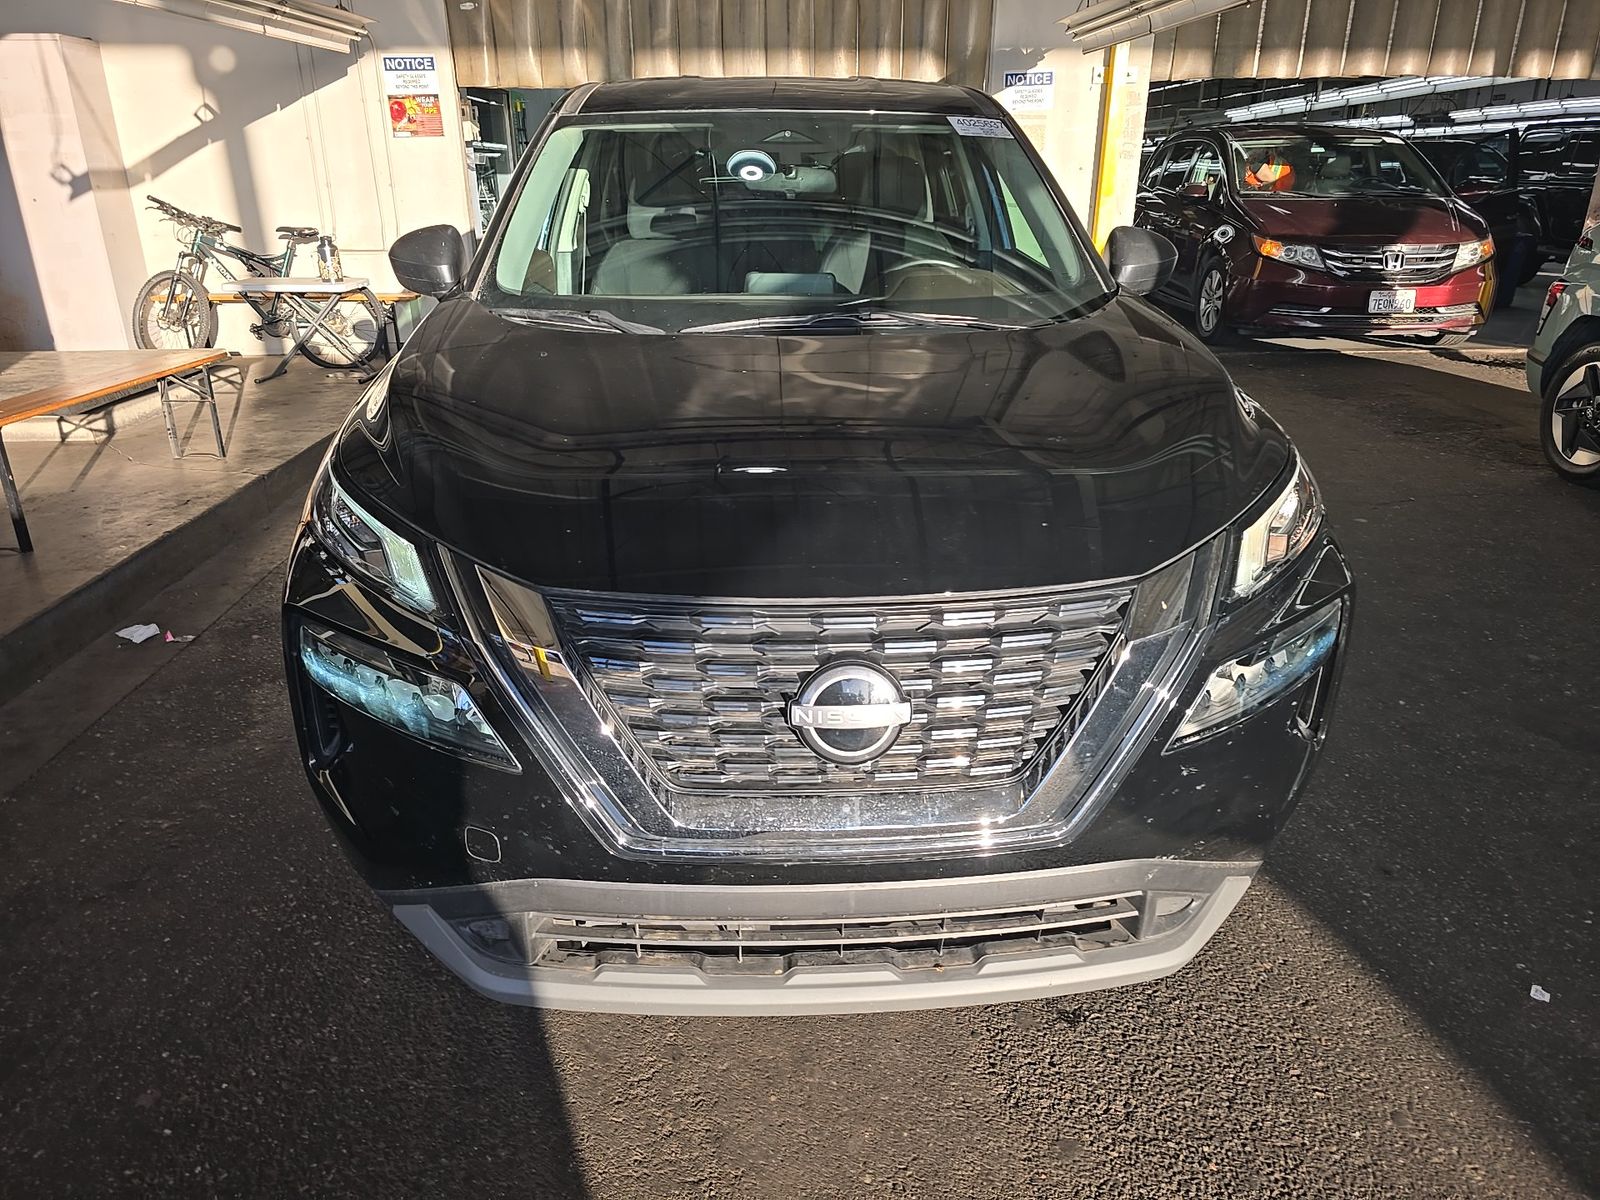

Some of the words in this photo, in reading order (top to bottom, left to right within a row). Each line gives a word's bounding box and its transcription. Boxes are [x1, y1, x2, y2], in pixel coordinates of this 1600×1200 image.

[385, 59, 433, 70] NOTICE
[1007, 73, 1051, 85] NOTICE
[795, 708, 906, 725] NISN
